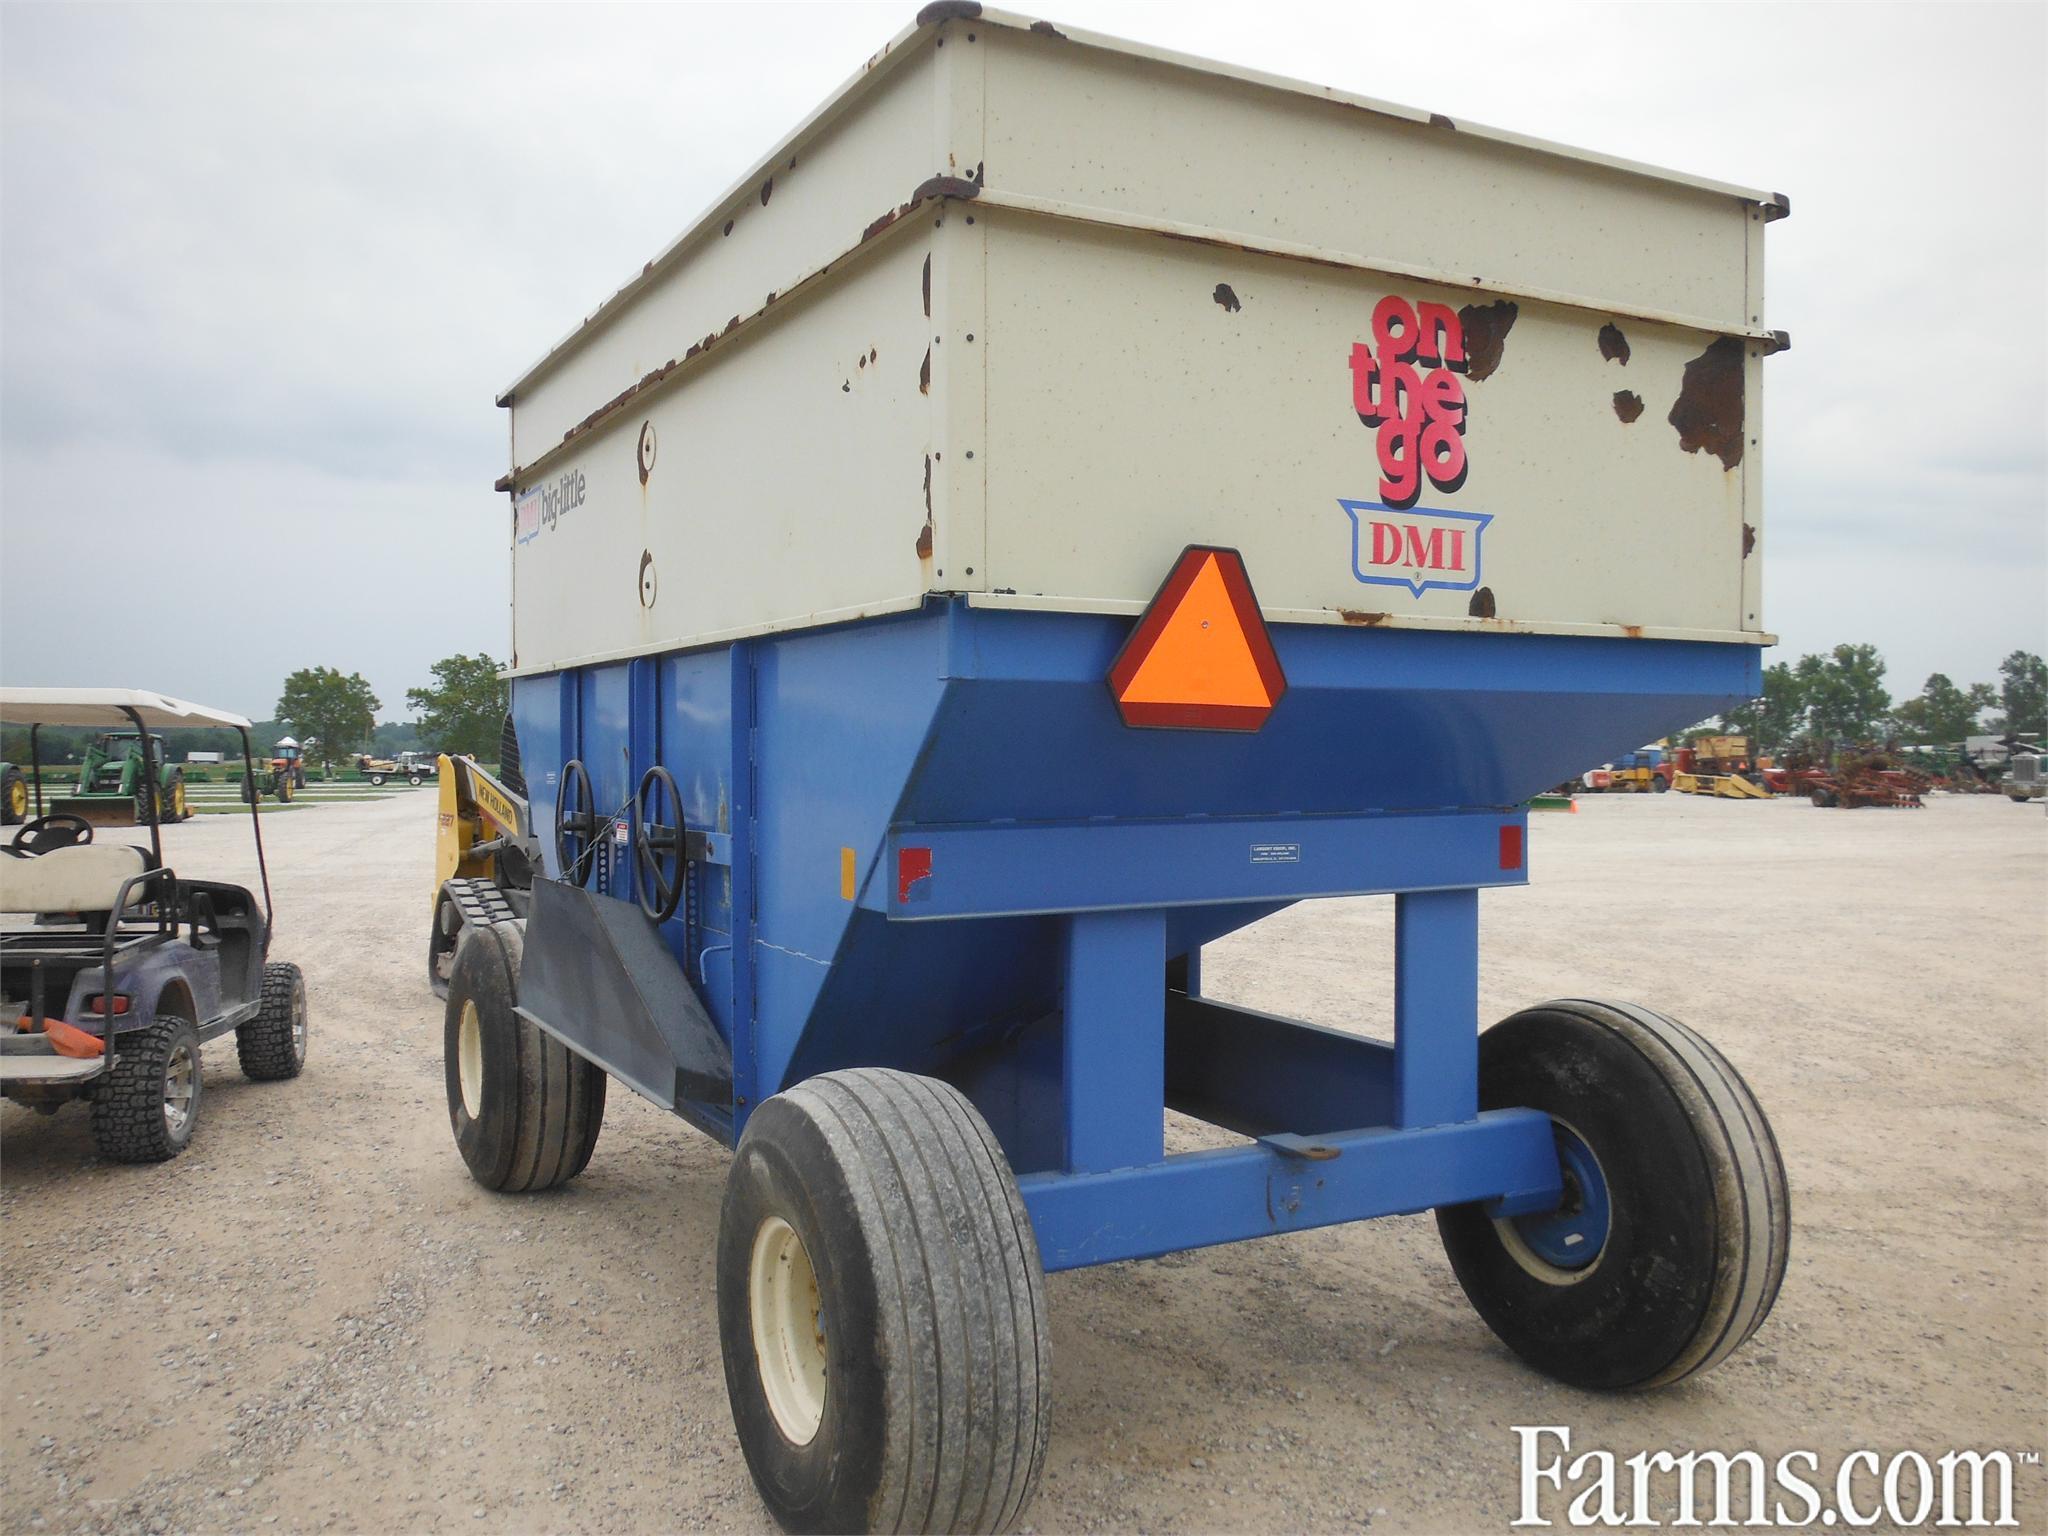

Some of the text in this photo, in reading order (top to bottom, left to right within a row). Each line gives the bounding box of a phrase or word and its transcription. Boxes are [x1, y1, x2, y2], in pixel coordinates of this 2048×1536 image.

[1372, 295, 1467, 373] on
[1349, 342, 1467, 430] the
[1376, 417, 1468, 510] go
[1368, 521, 1467, 572] DMI
[489, 791, 513, 825] HOLLAND
